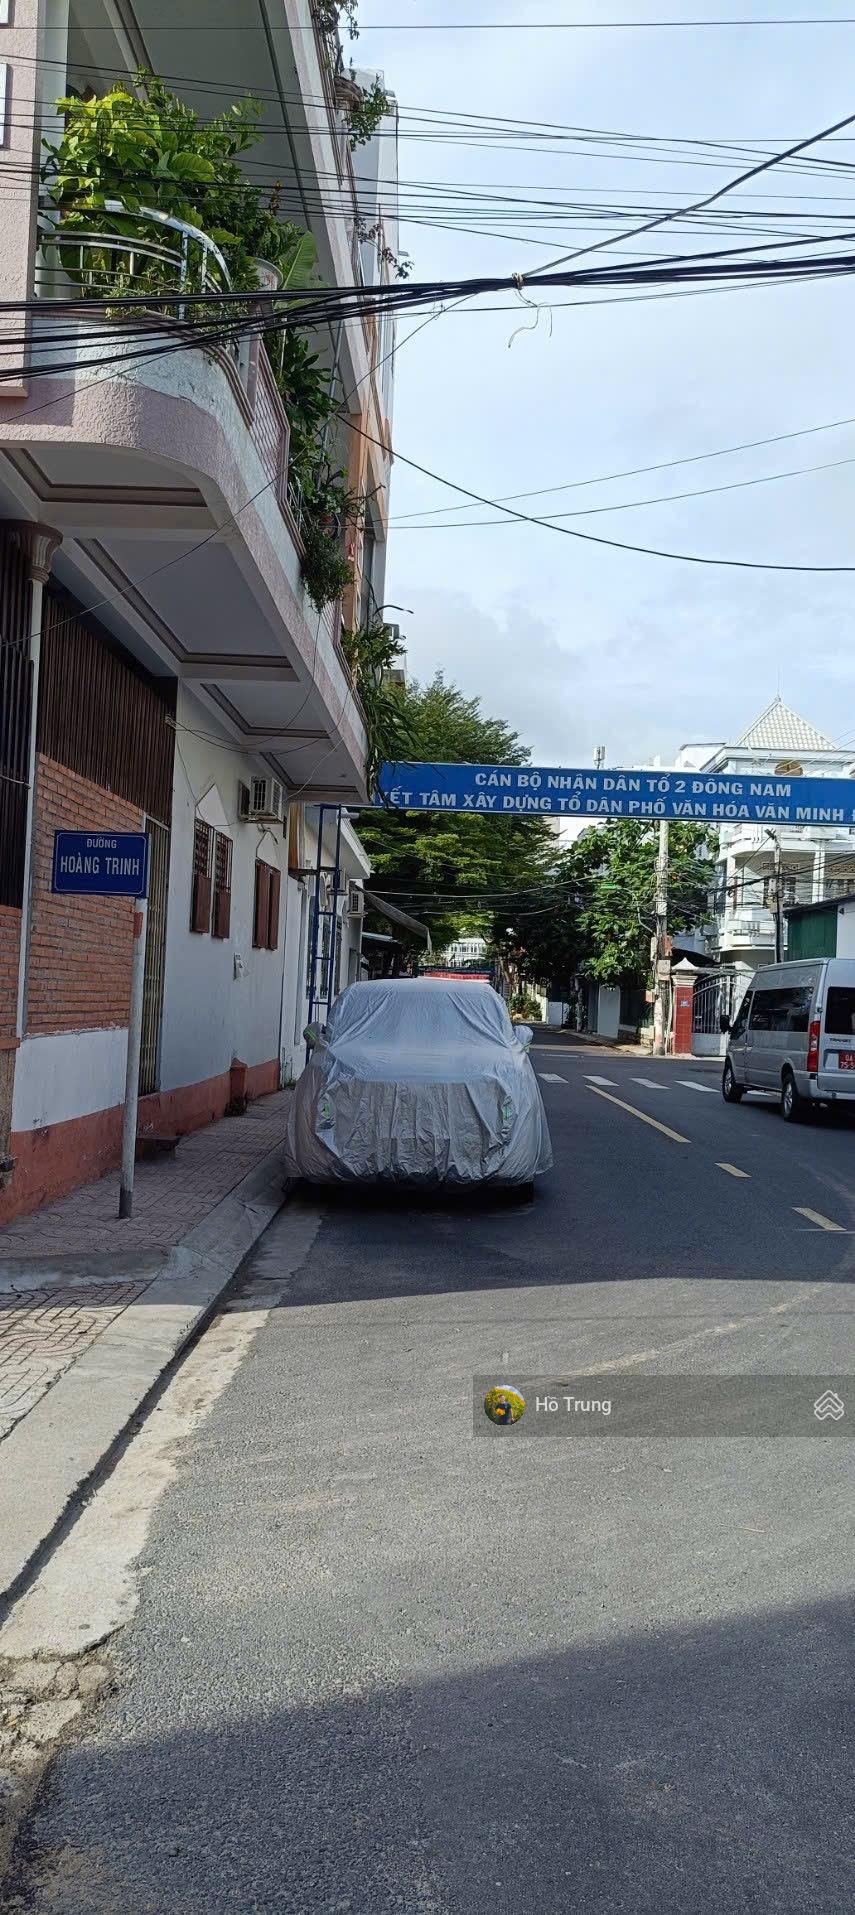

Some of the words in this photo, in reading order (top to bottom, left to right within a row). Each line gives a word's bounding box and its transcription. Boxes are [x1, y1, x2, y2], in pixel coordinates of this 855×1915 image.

[475, 770, 511, 787] CÁN
[517, 771, 542, 791] BỘ
[548, 773, 597, 790] NHÂN
[603, 774, 640, 792] DÂN
[647, 773, 671, 793] TỔ
[674, 780, 686, 793] 2
[691, 778, 743, 795] ĐÔNG
[750, 783, 791, 797] NAM
[419, 790, 456, 807] TÂM
[462, 791, 497, 808] XÂY
[503, 794, 551, 812] DỰNG
[557, 791, 581, 811] TỔ
[586, 796, 622, 813] DÂN
[628, 796, 666, 815] PHỐ
[672, 799, 707, 816] VĂN
[712, 800, 749, 818] HÓA
[755, 803, 789, 819] VĂN
[796, 807, 844, 822] MINH
[86, 837, 117, 849] ĐƯỜNG
[60, 852, 100, 874] HOÀNG
[105, 857, 140, 875] TRINH
